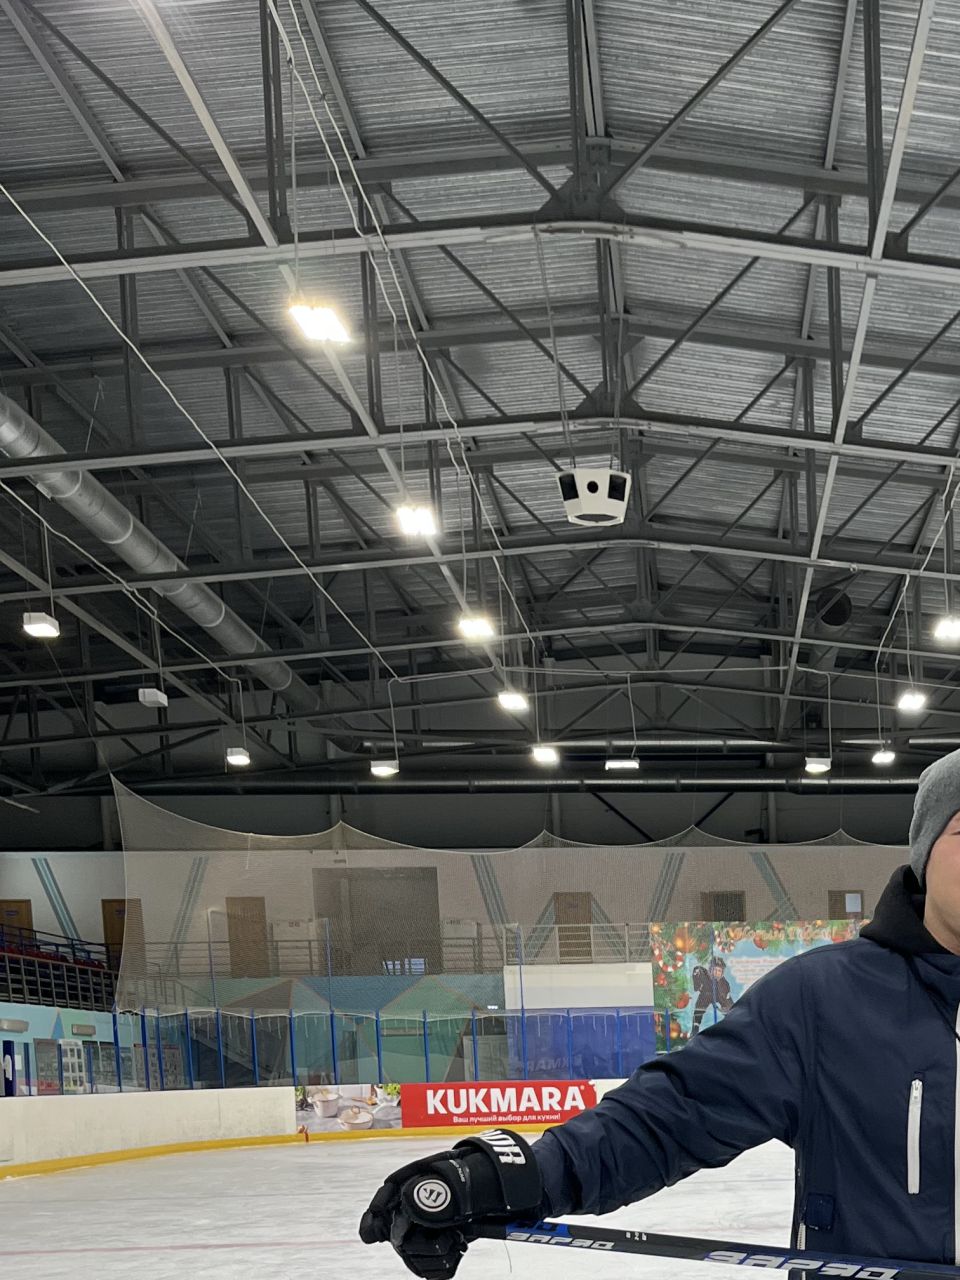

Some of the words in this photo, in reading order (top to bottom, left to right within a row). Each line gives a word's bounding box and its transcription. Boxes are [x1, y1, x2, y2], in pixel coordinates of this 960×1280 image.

[427, 1086, 586, 1115] KUKMARA
[452, 1116, 469, 1124] Ваш
[469, 1114, 498, 1124] лучший
[498, 1113, 522, 1123] выбор
[522, 1114, 537, 1122] для
[537, 1113, 561, 1122] кухни!
